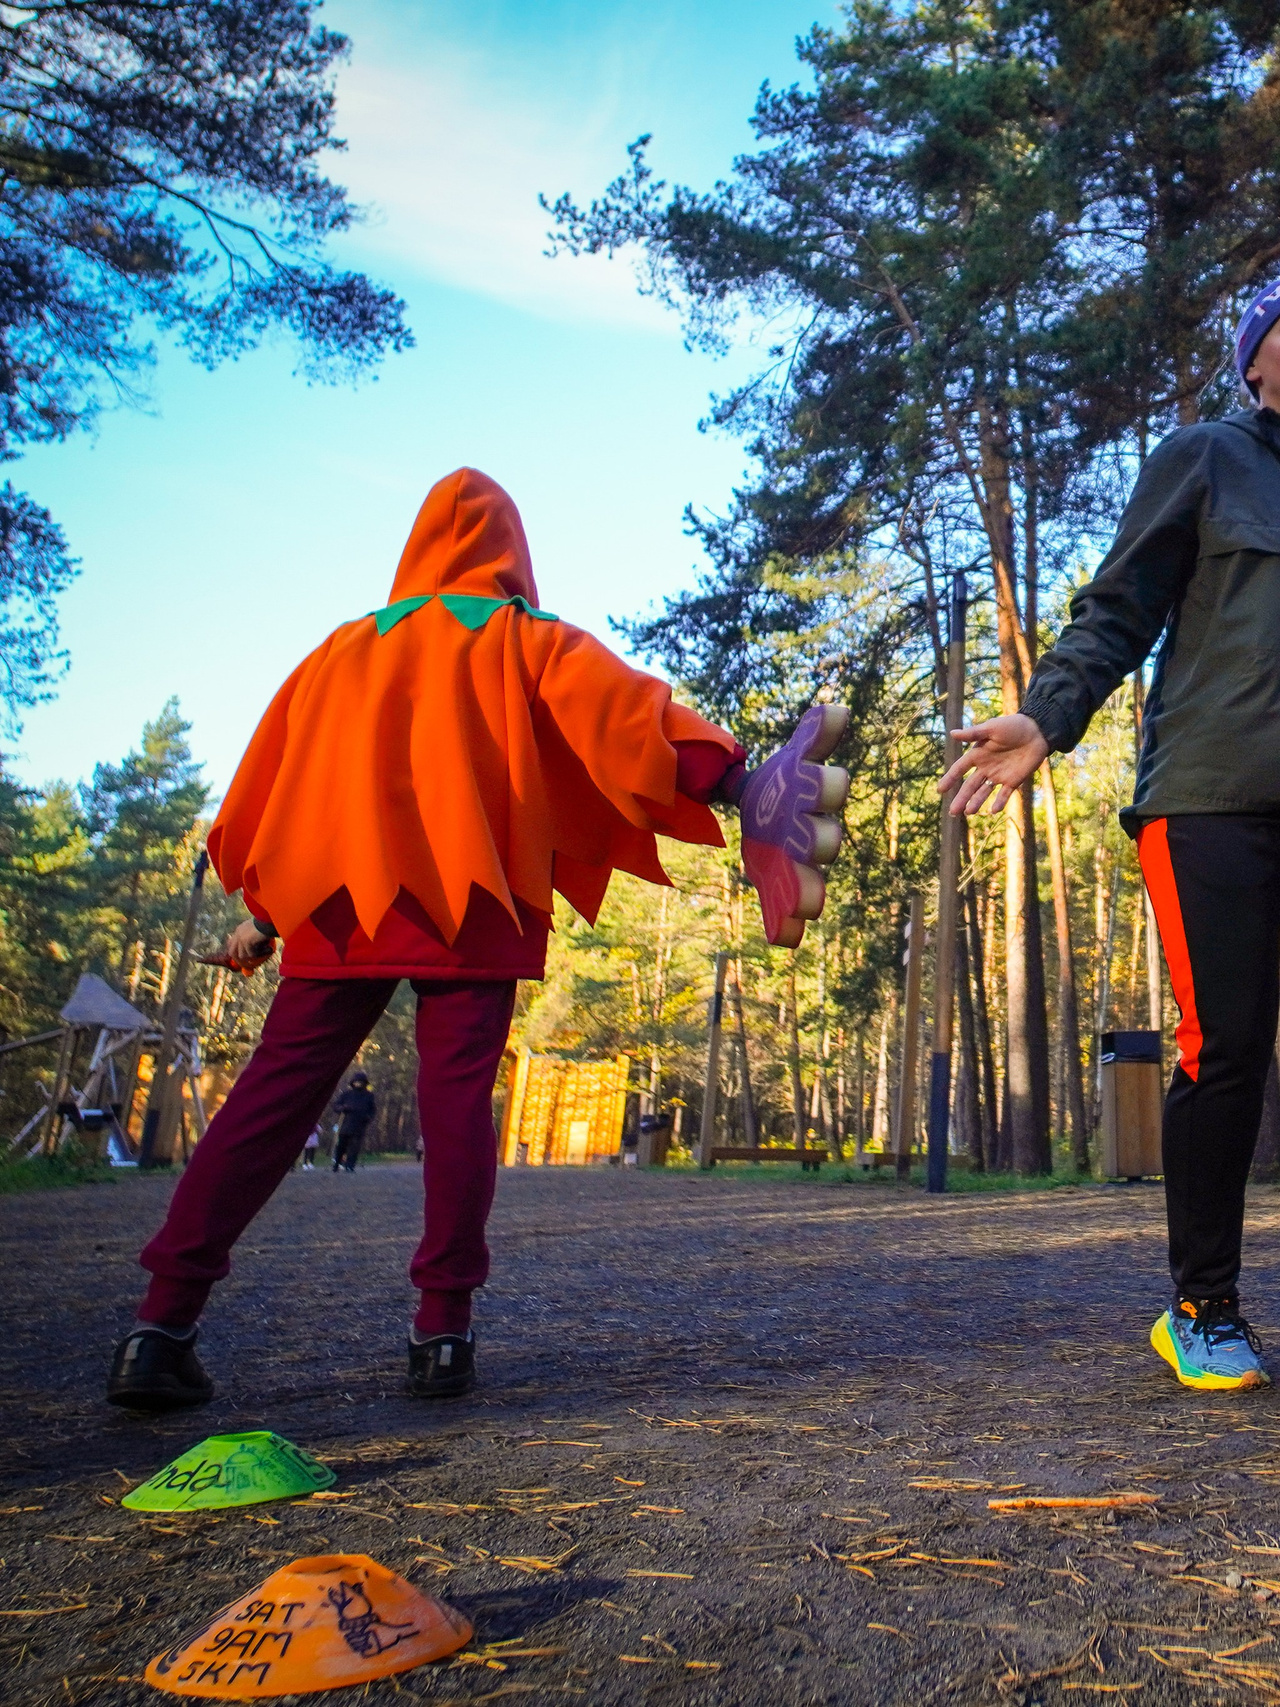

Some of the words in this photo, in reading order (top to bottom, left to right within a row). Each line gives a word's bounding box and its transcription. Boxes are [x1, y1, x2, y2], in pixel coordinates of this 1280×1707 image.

[234, 1600, 305, 1624] SAT
[203, 1627, 293, 1659] 9AM
[178, 1660, 271, 1686] 5KM
